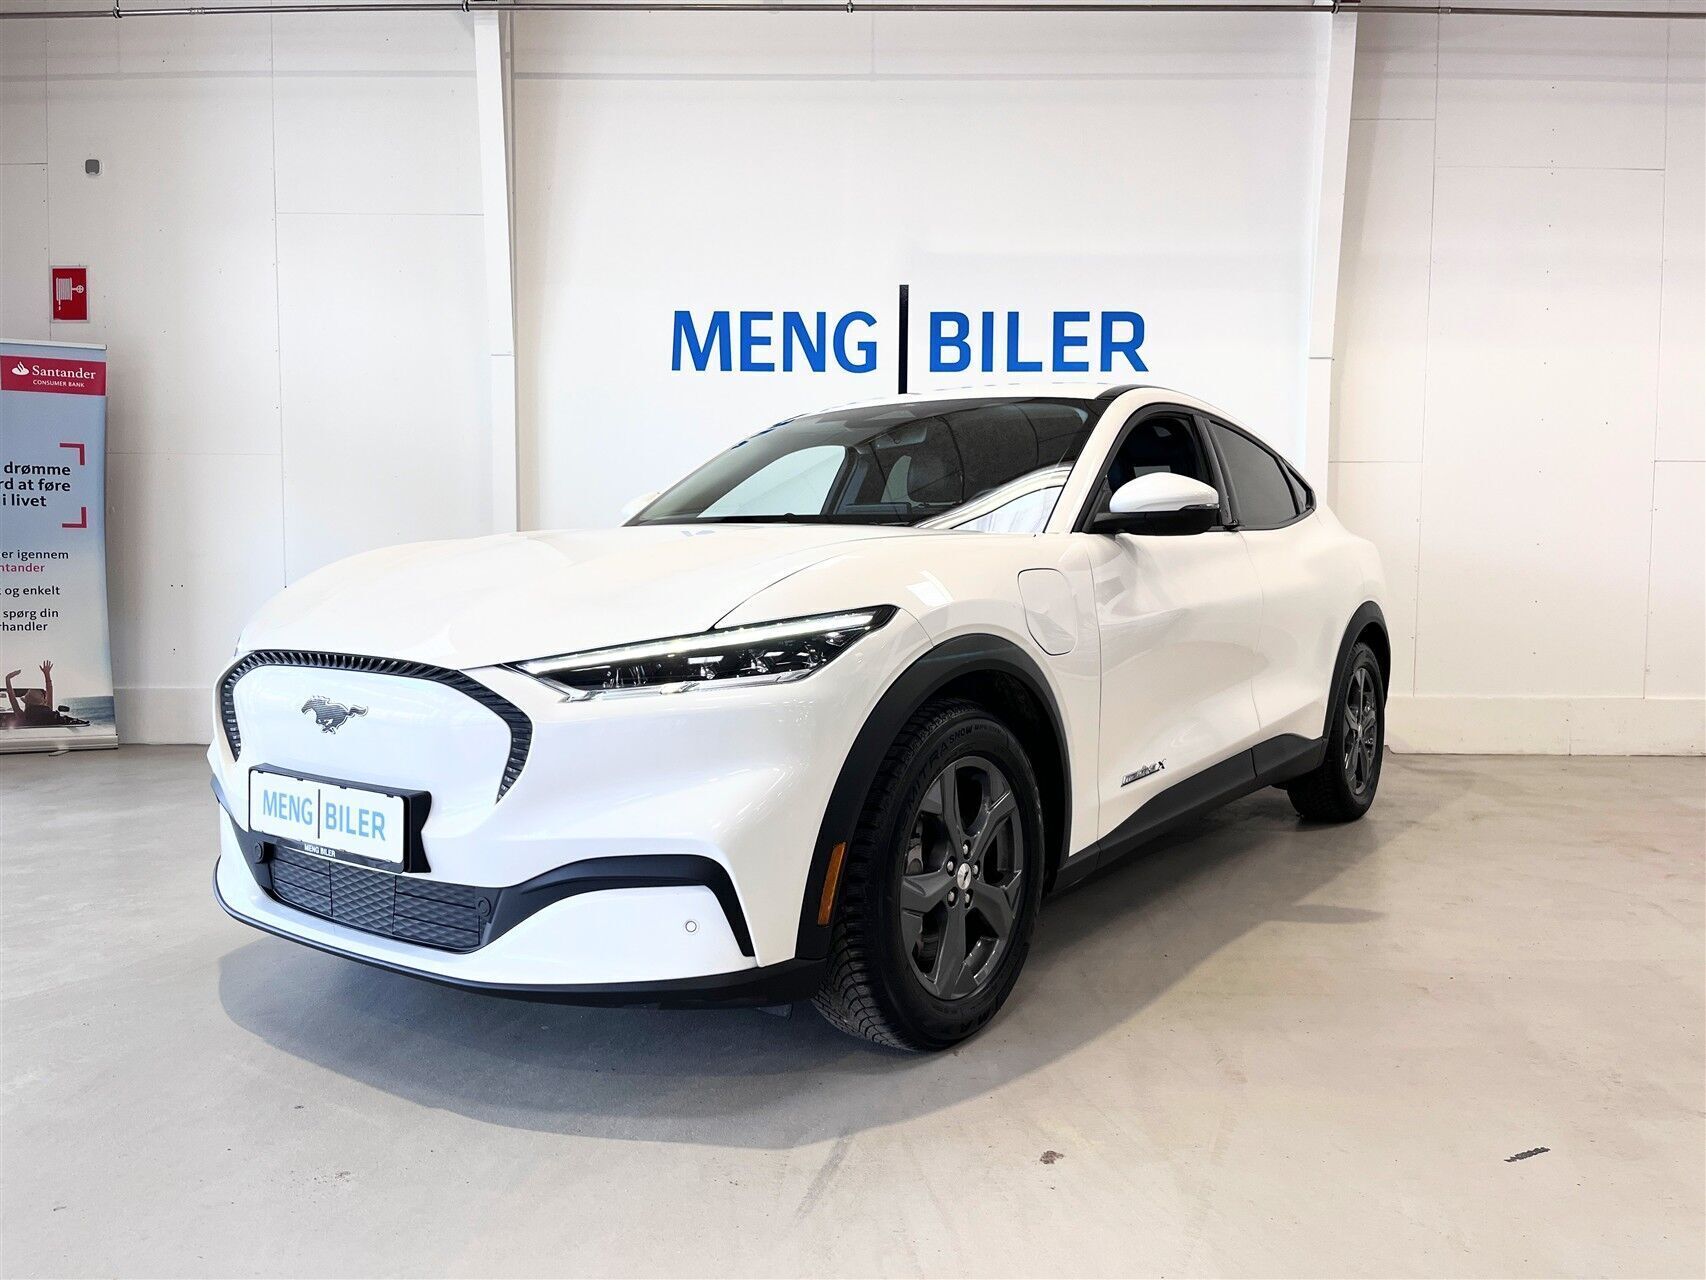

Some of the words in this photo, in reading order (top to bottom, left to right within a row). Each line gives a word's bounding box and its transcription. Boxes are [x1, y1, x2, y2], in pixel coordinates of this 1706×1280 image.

[671, 310, 878, 374] MENG
[929, 310, 1150, 373] BILER
[32, 364, 97, 380] Santander
[33, 379, 67, 387] CONSUMER
[4, 460, 71, 476] drømme
[18, 479, 34, 491] at
[38, 478, 71, 492] føre
[11, 493, 47, 507] livet
[1, 551, 14, 559] er
[17, 549, 69, 561] igennem
[4, 587, 20, 598] og
[22, 585, 60, 596] enkelt
[3, 610, 37, 621] spørg
[40, 608, 59, 618] din
[0, 621, 48, 631] handler
[262, 789, 313, 826] MENG
[325, 802, 386, 841] BILER
[304, 843, 320, 854] MENG
[320, 847, 336, 858] BILER
